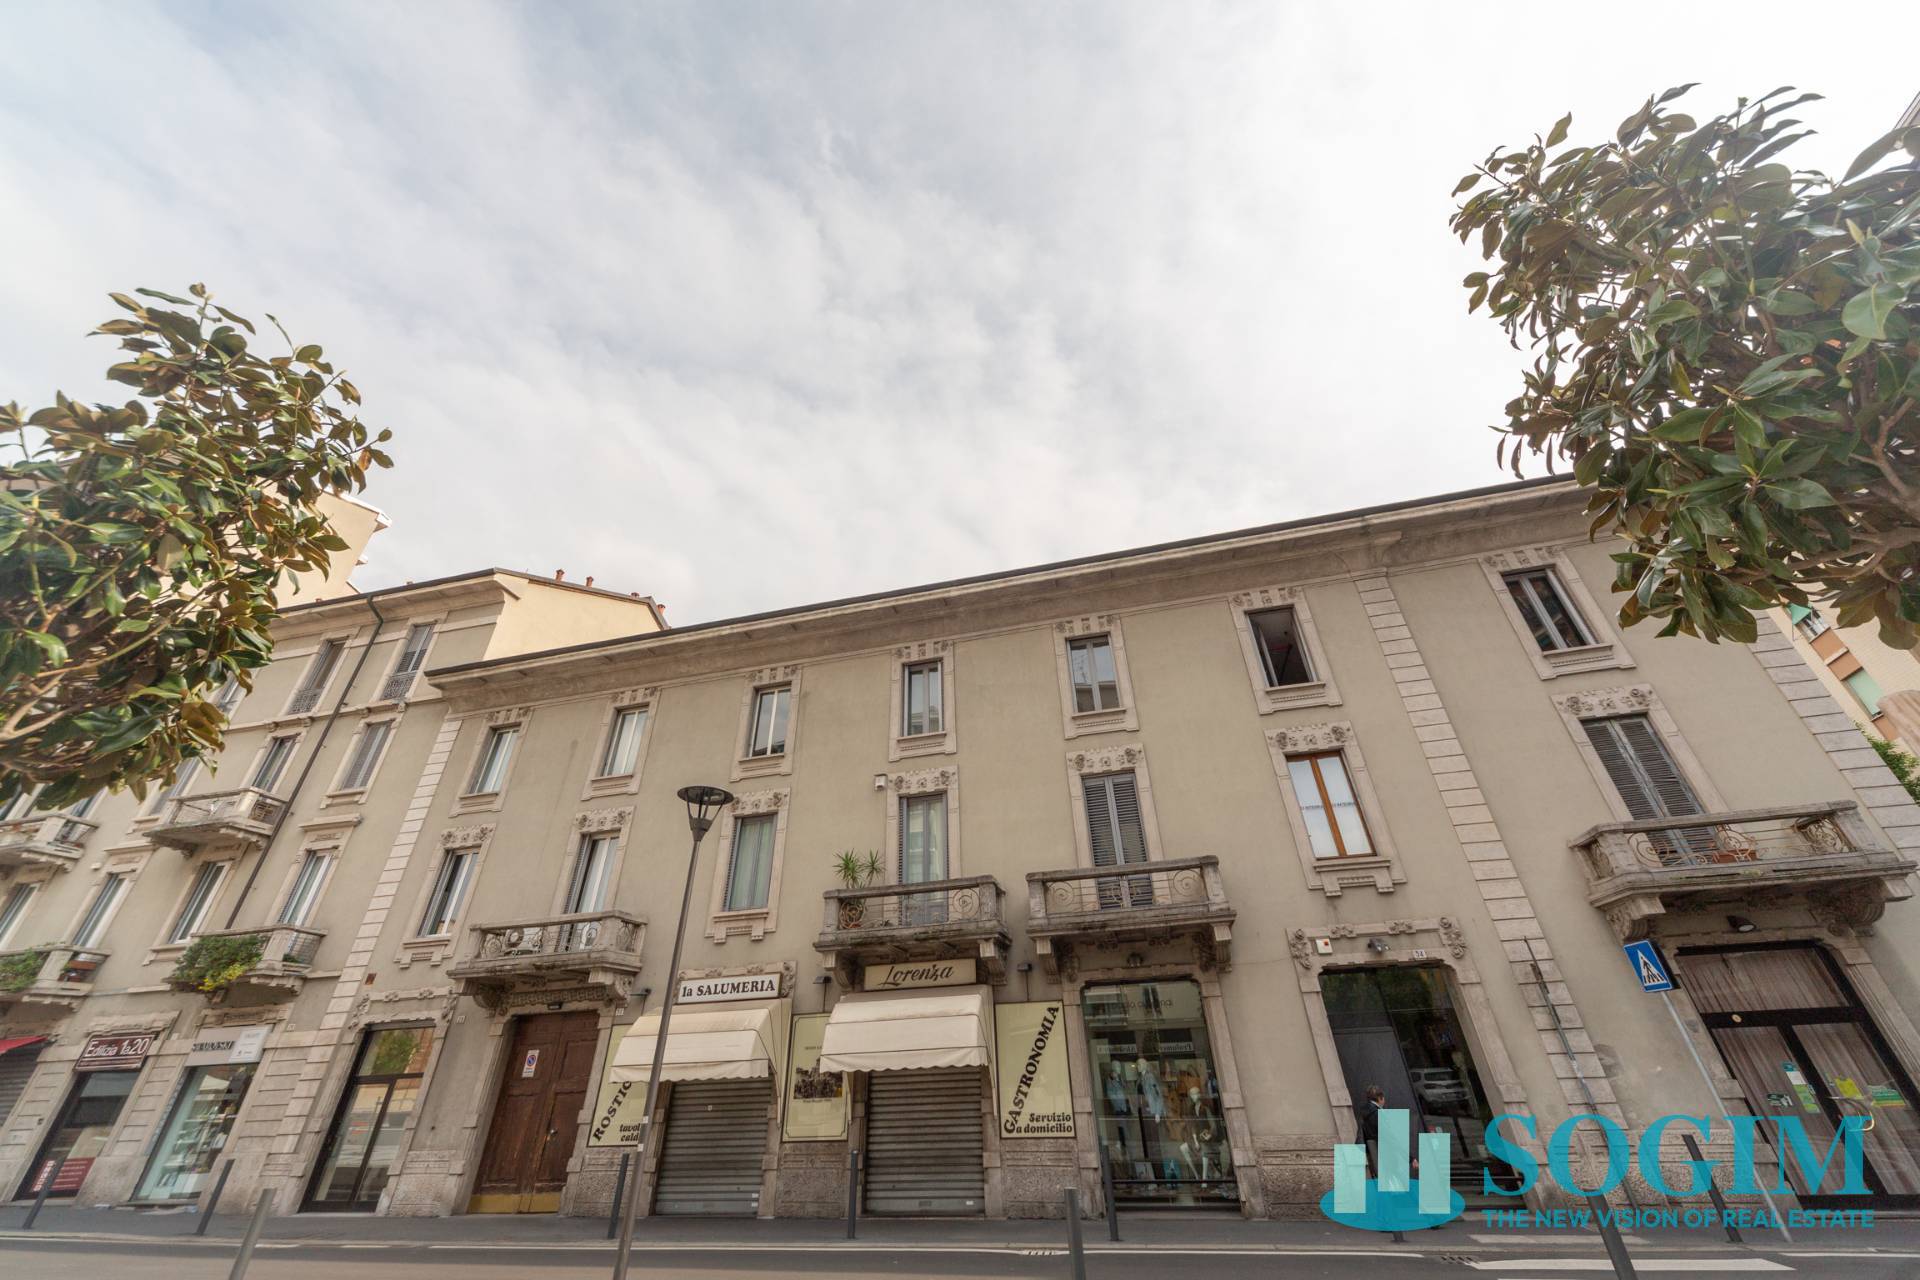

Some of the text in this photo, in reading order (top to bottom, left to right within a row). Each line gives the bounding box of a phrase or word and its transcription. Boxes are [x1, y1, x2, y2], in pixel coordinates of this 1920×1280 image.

[878, 964, 954, 987] Lorenza
[682, 979, 775, 997] la SALUMERIA
[1003, 1006, 1060, 1135] GASTRONOMIA
[593, 1081, 632, 1142] ROSTIC
[1029, 1112, 1072, 1123] Servizio
[619, 1123, 641, 1132] tavol
[1023, 1123, 1073, 1134] domicilio
[620, 1133, 640, 1142] cald
